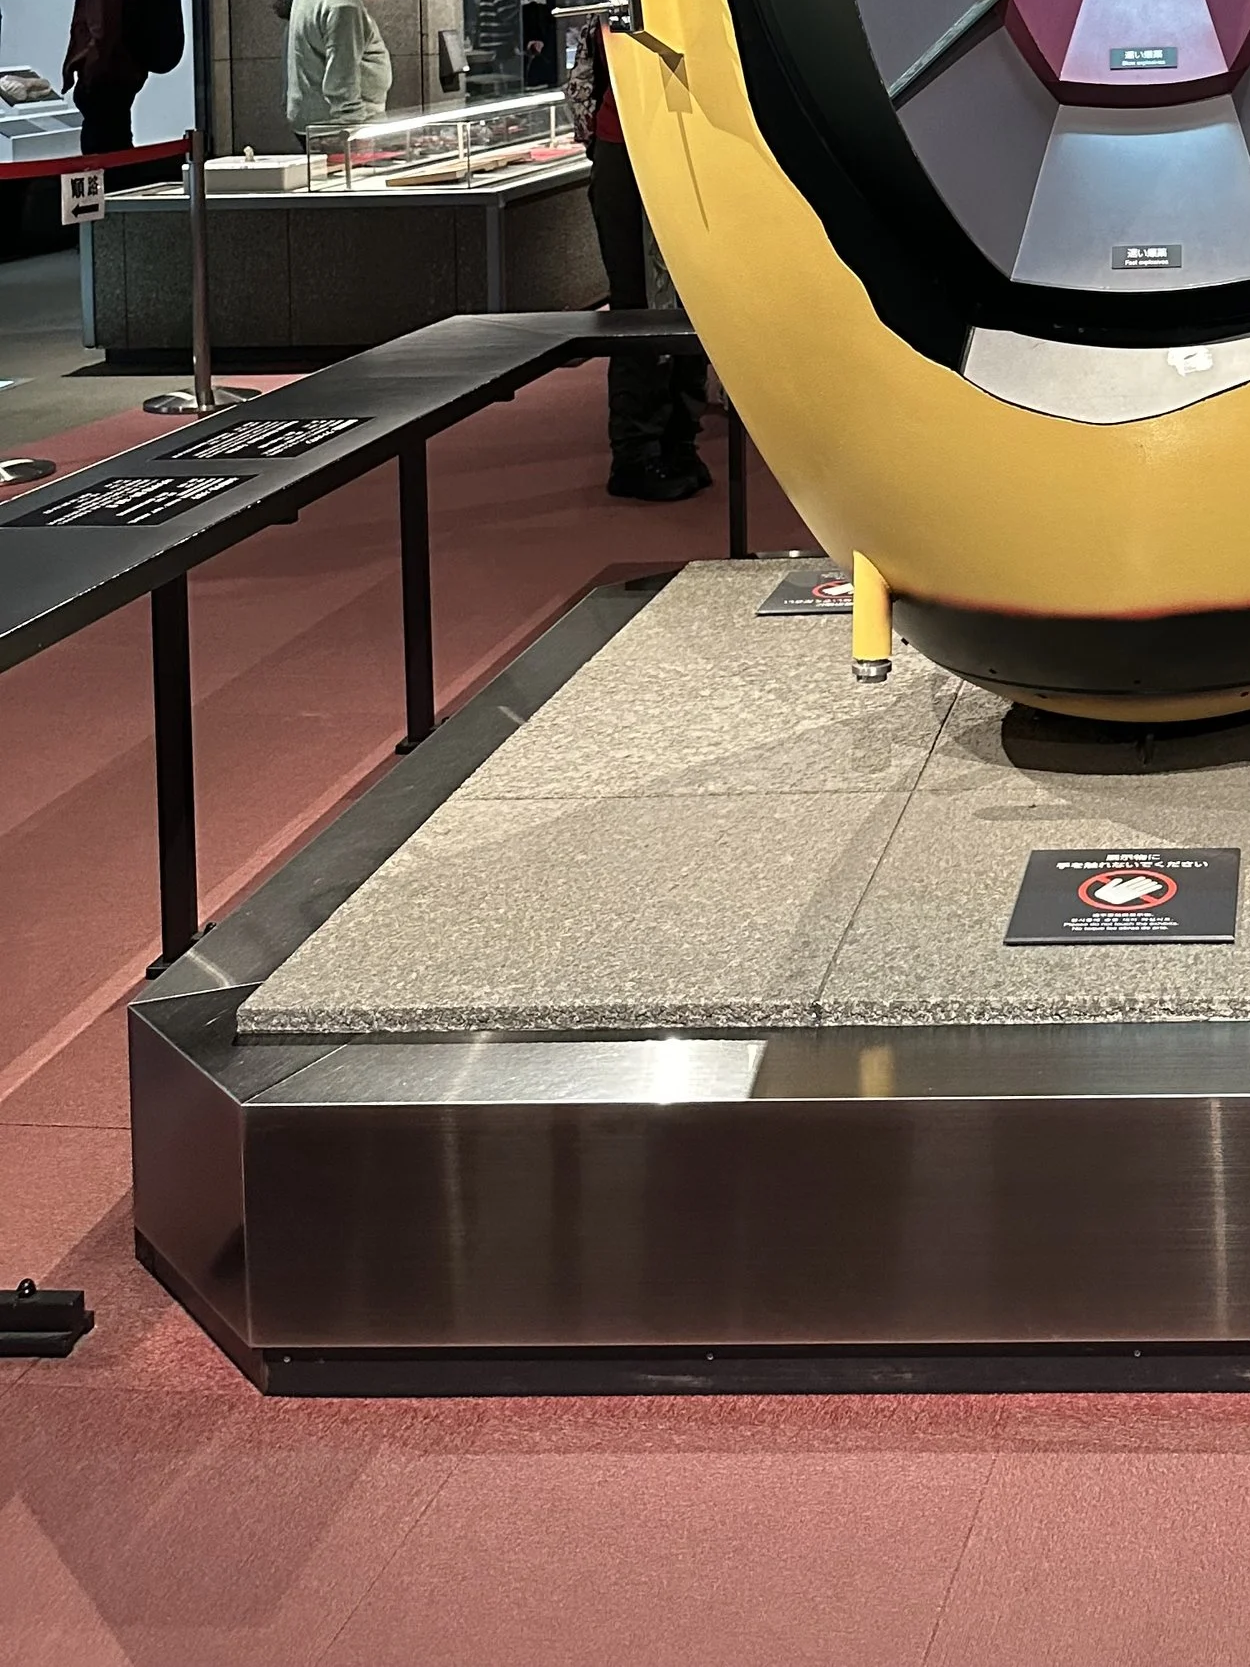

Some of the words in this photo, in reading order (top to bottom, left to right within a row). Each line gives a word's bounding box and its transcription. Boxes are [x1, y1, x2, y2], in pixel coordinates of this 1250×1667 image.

[70, 175, 100, 198] 順路
[1056, 861, 1209, 870] 手を触れないでください
